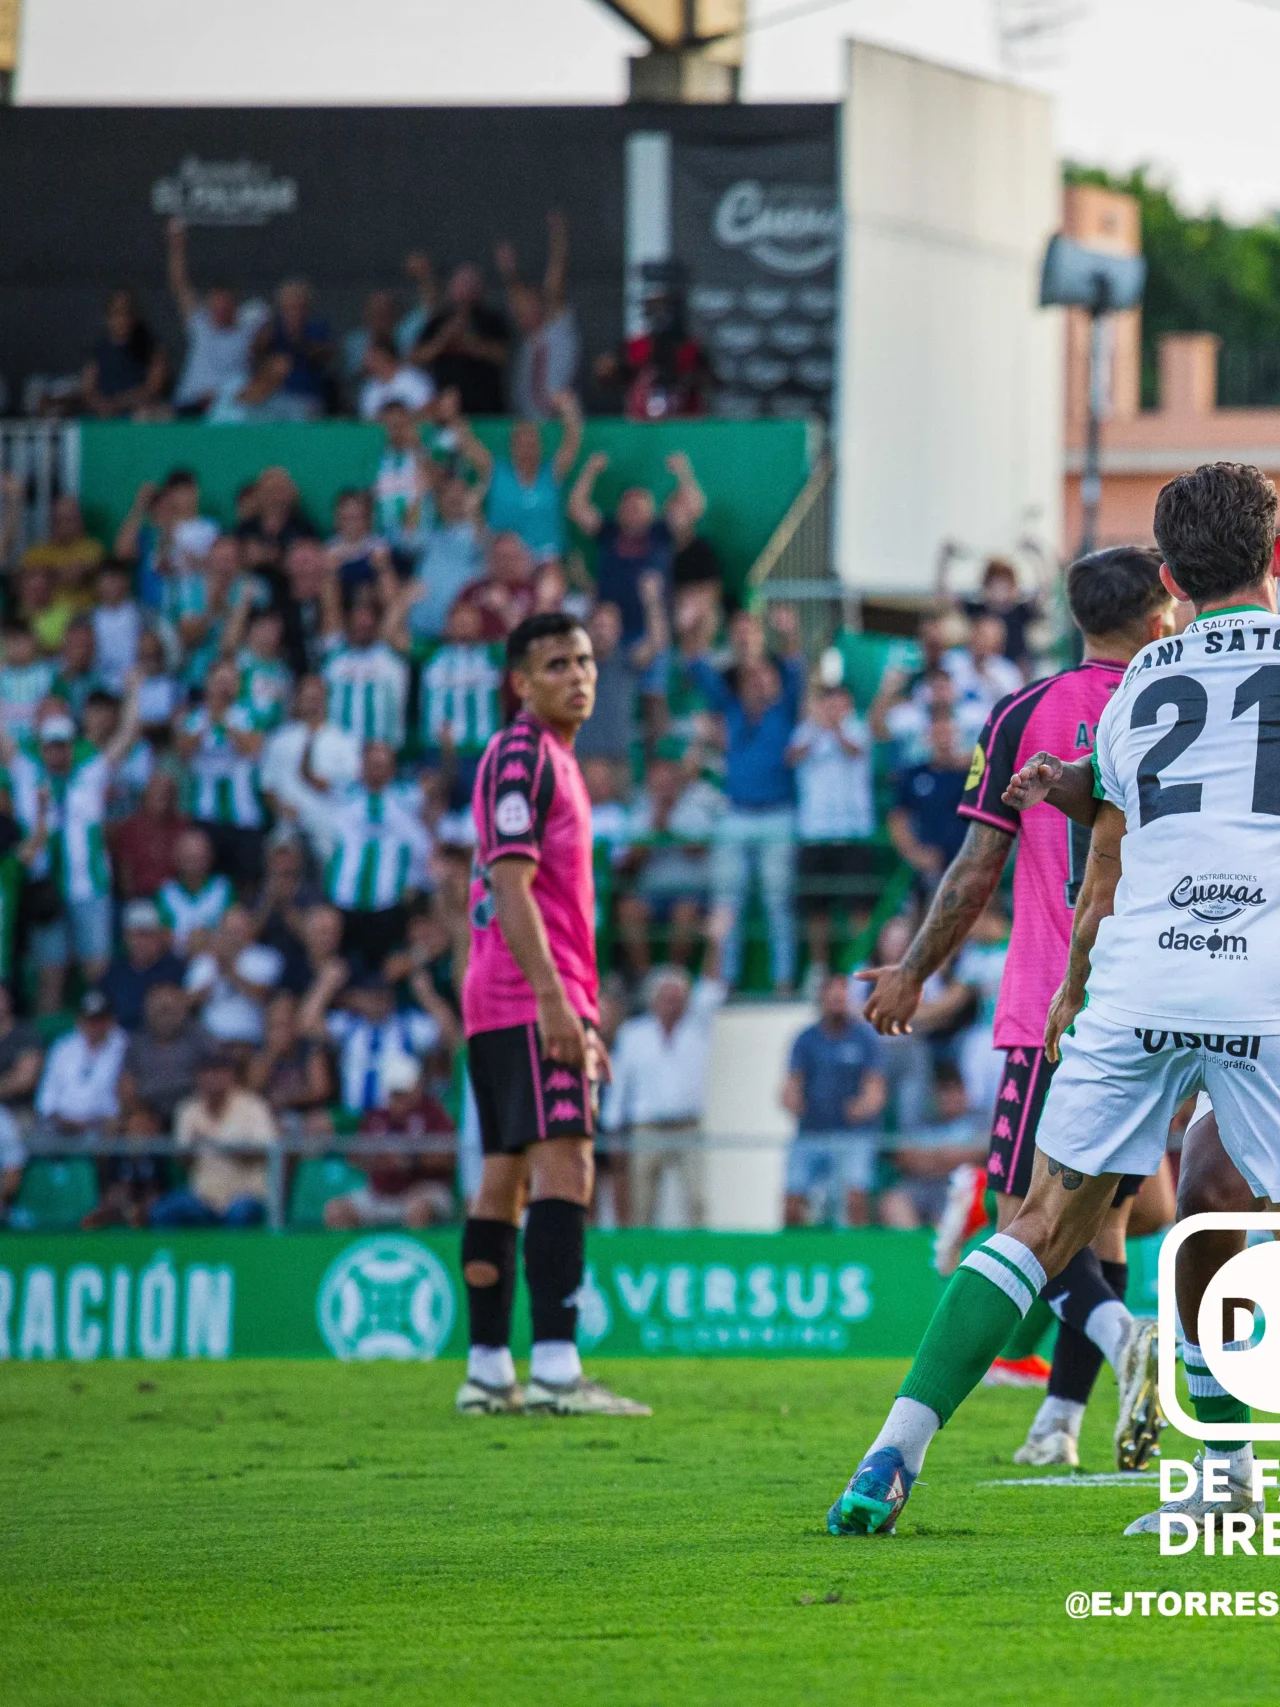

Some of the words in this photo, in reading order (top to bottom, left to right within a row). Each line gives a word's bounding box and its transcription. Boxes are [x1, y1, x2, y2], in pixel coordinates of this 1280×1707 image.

[1168, 875, 1267, 910] Cuevas
[1196, 873, 1258, 882] DISTRIBUCIONES
[1158, 926, 1248, 954] dacom
[613, 1264, 872, 1319] VERSUS
